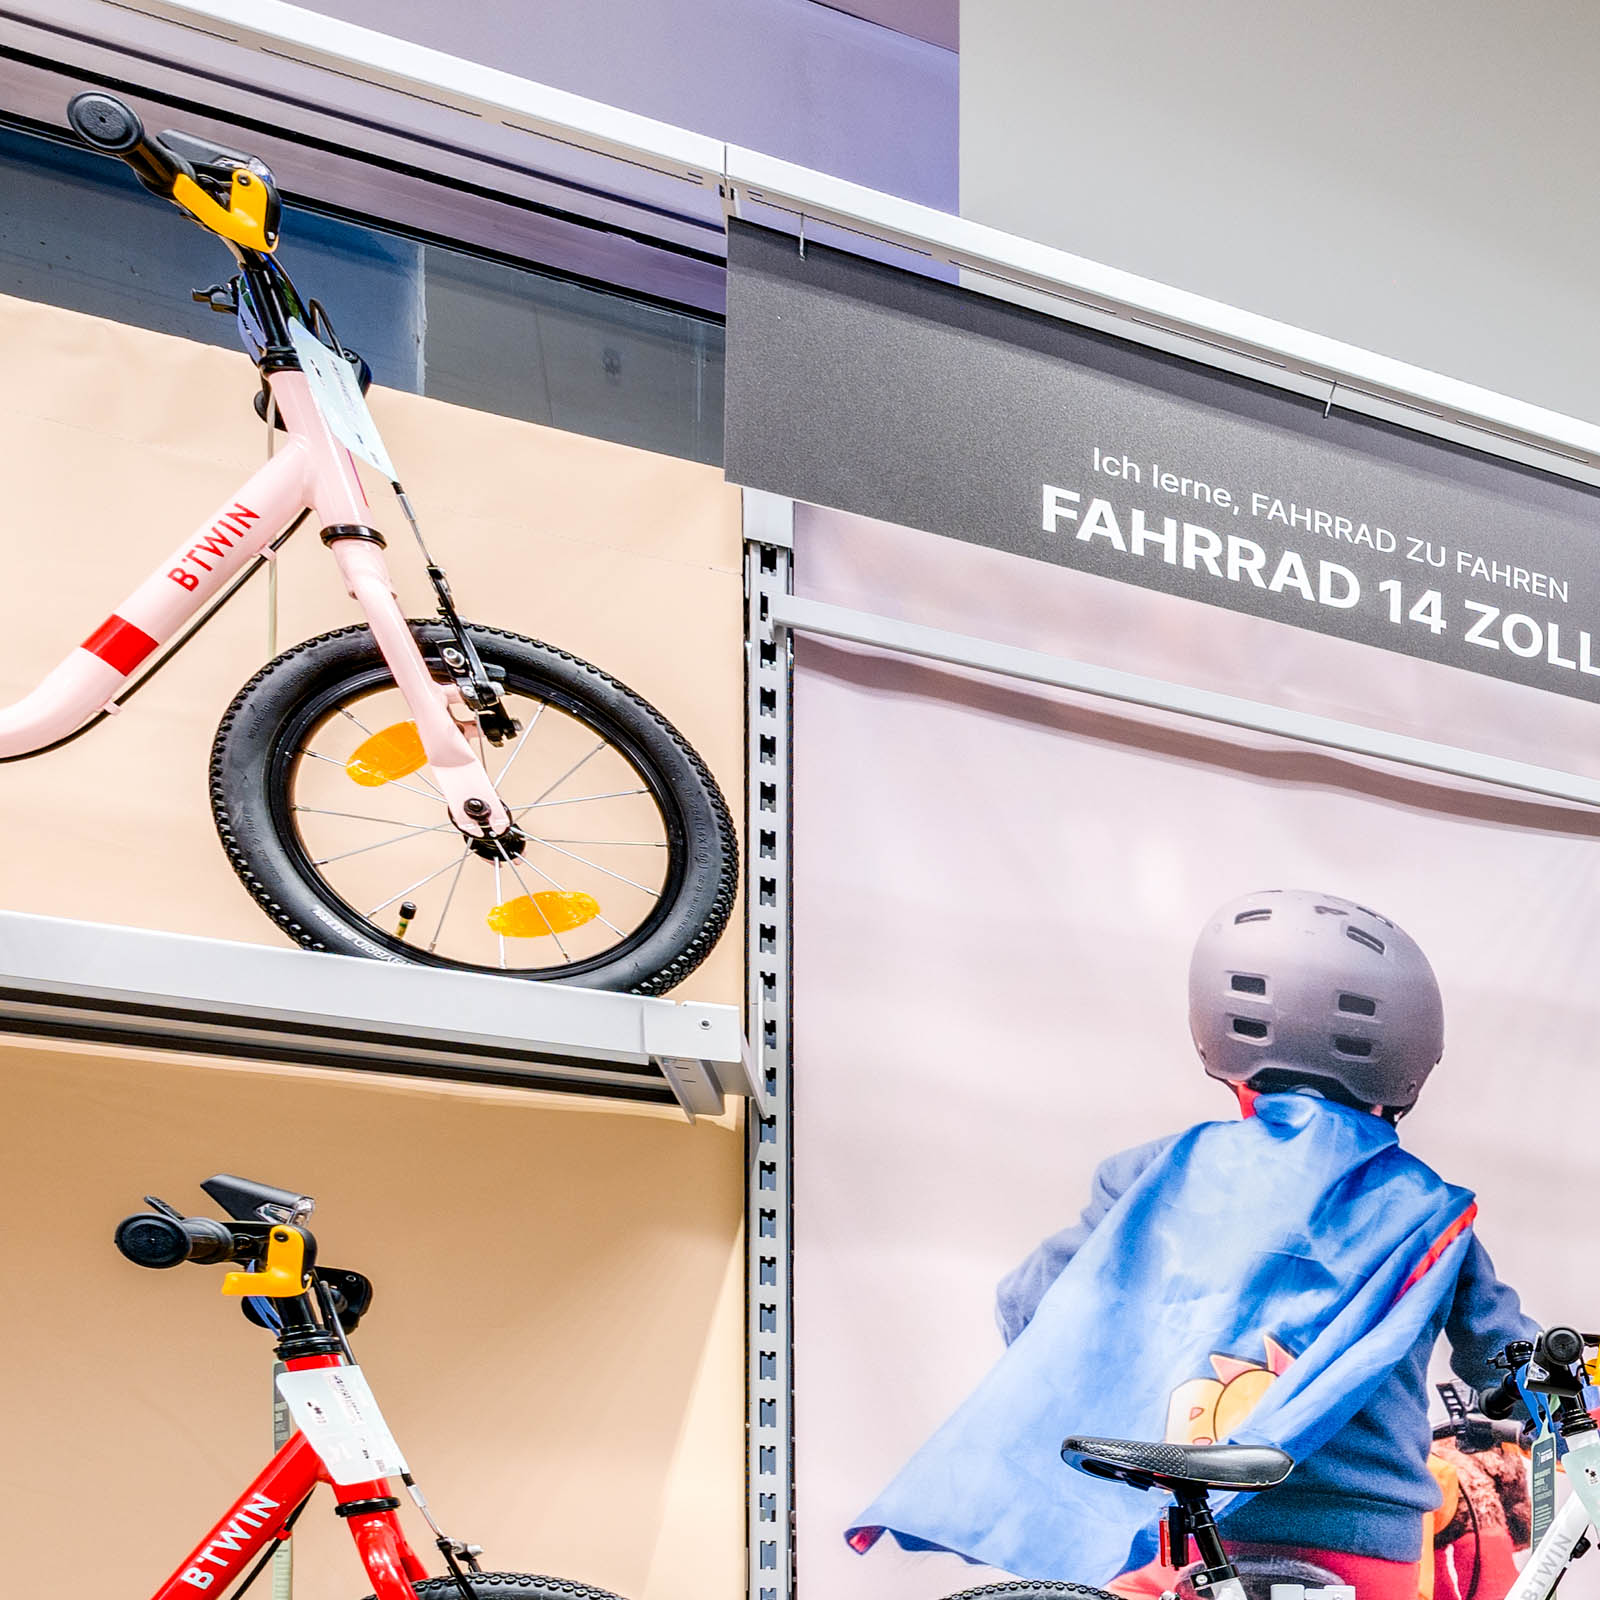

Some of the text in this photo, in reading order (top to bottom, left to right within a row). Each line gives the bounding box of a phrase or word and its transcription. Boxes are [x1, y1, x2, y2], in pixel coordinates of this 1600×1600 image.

[1041, 484, 1361, 609] FAHRRAD
[1379, 580, 1447, 635] 14
[1093, 447, 1569, 603] Ich lerne, FAHRRAD ZU FAHREN
